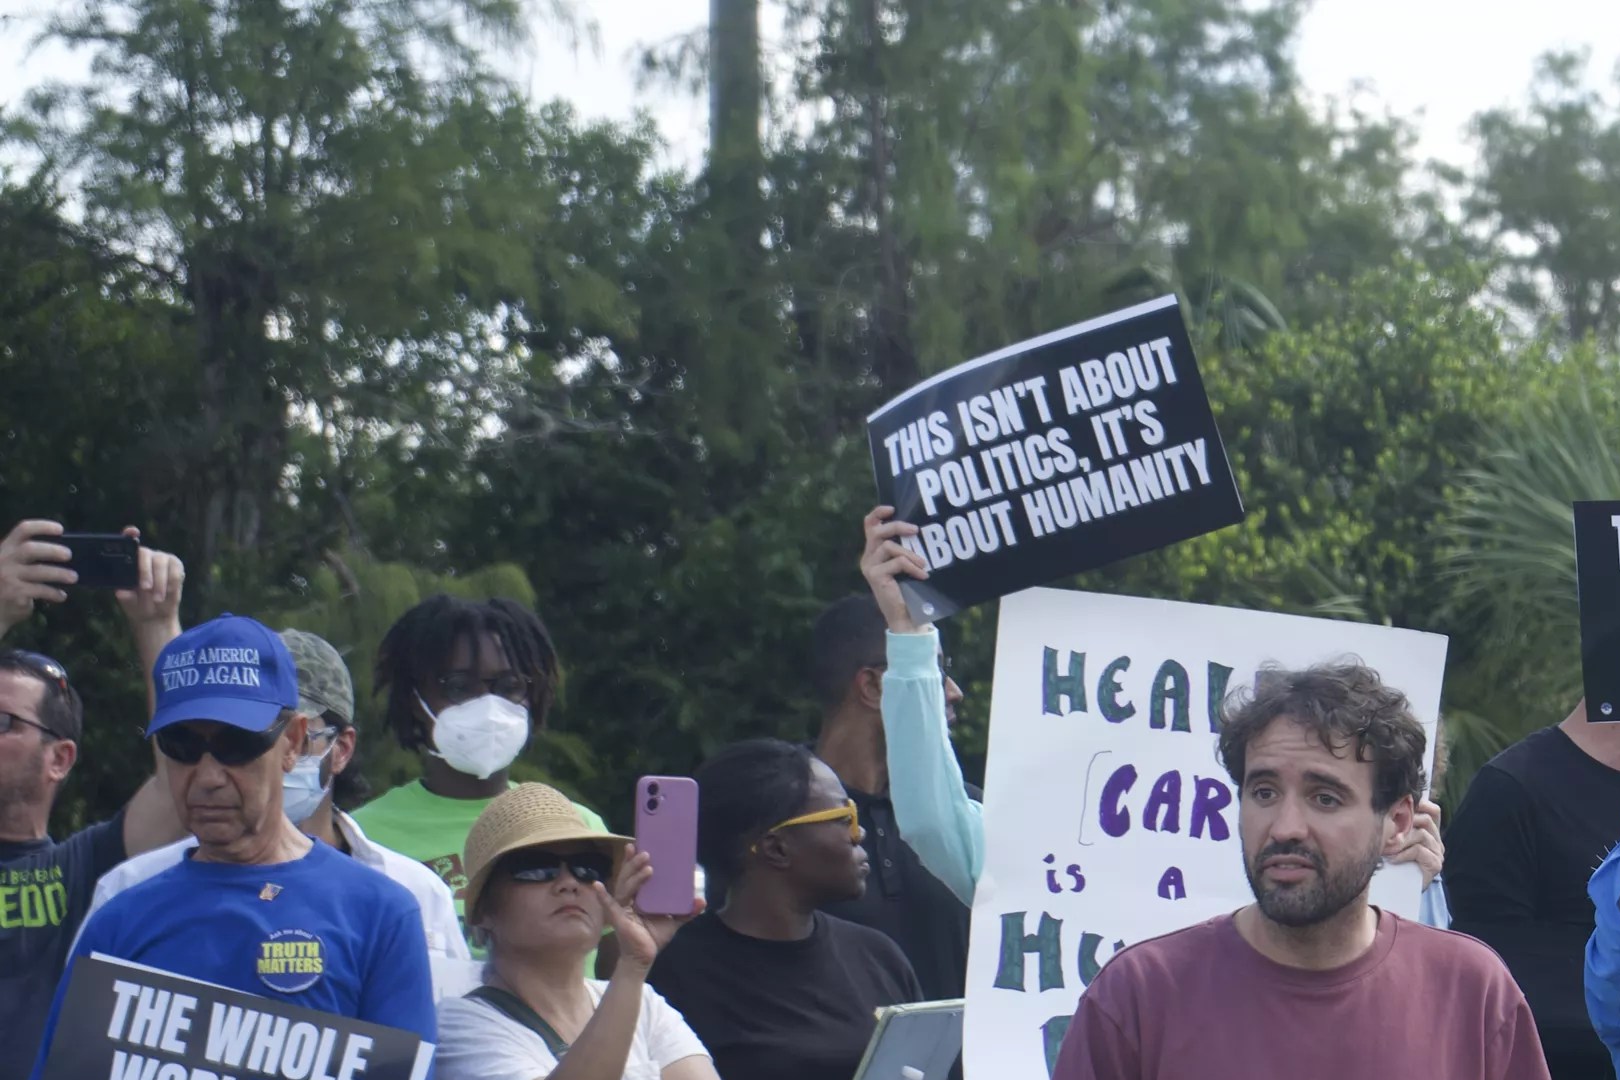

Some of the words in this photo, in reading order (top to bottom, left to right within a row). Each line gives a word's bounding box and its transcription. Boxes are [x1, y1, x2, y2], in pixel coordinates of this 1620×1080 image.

[883, 410, 955, 477] THIS
[956, 376, 1053, 447] ISN'T
[1058, 336, 1178, 415] ABOUT
[915, 427, 1091, 516] POLITICS,
[1091, 400, 1165, 460] IT'S
[900, 501, 1018, 574] ABOUT
[1021, 438, 1211, 537] HUMANITY
[161, 668, 199, 692] KIND
[204, 666, 260, 687] AGAIN
[163, 650, 195, 669] MAKE
[198, 648, 260, 665] AMERICA
[1098, 763, 1234, 842] CAR
[1042, 853, 1086, 893] is
[257, 957, 323, 974] MATTERS
[261, 942, 319, 958] TRUTH
[107, 979, 198, 1055] THE
